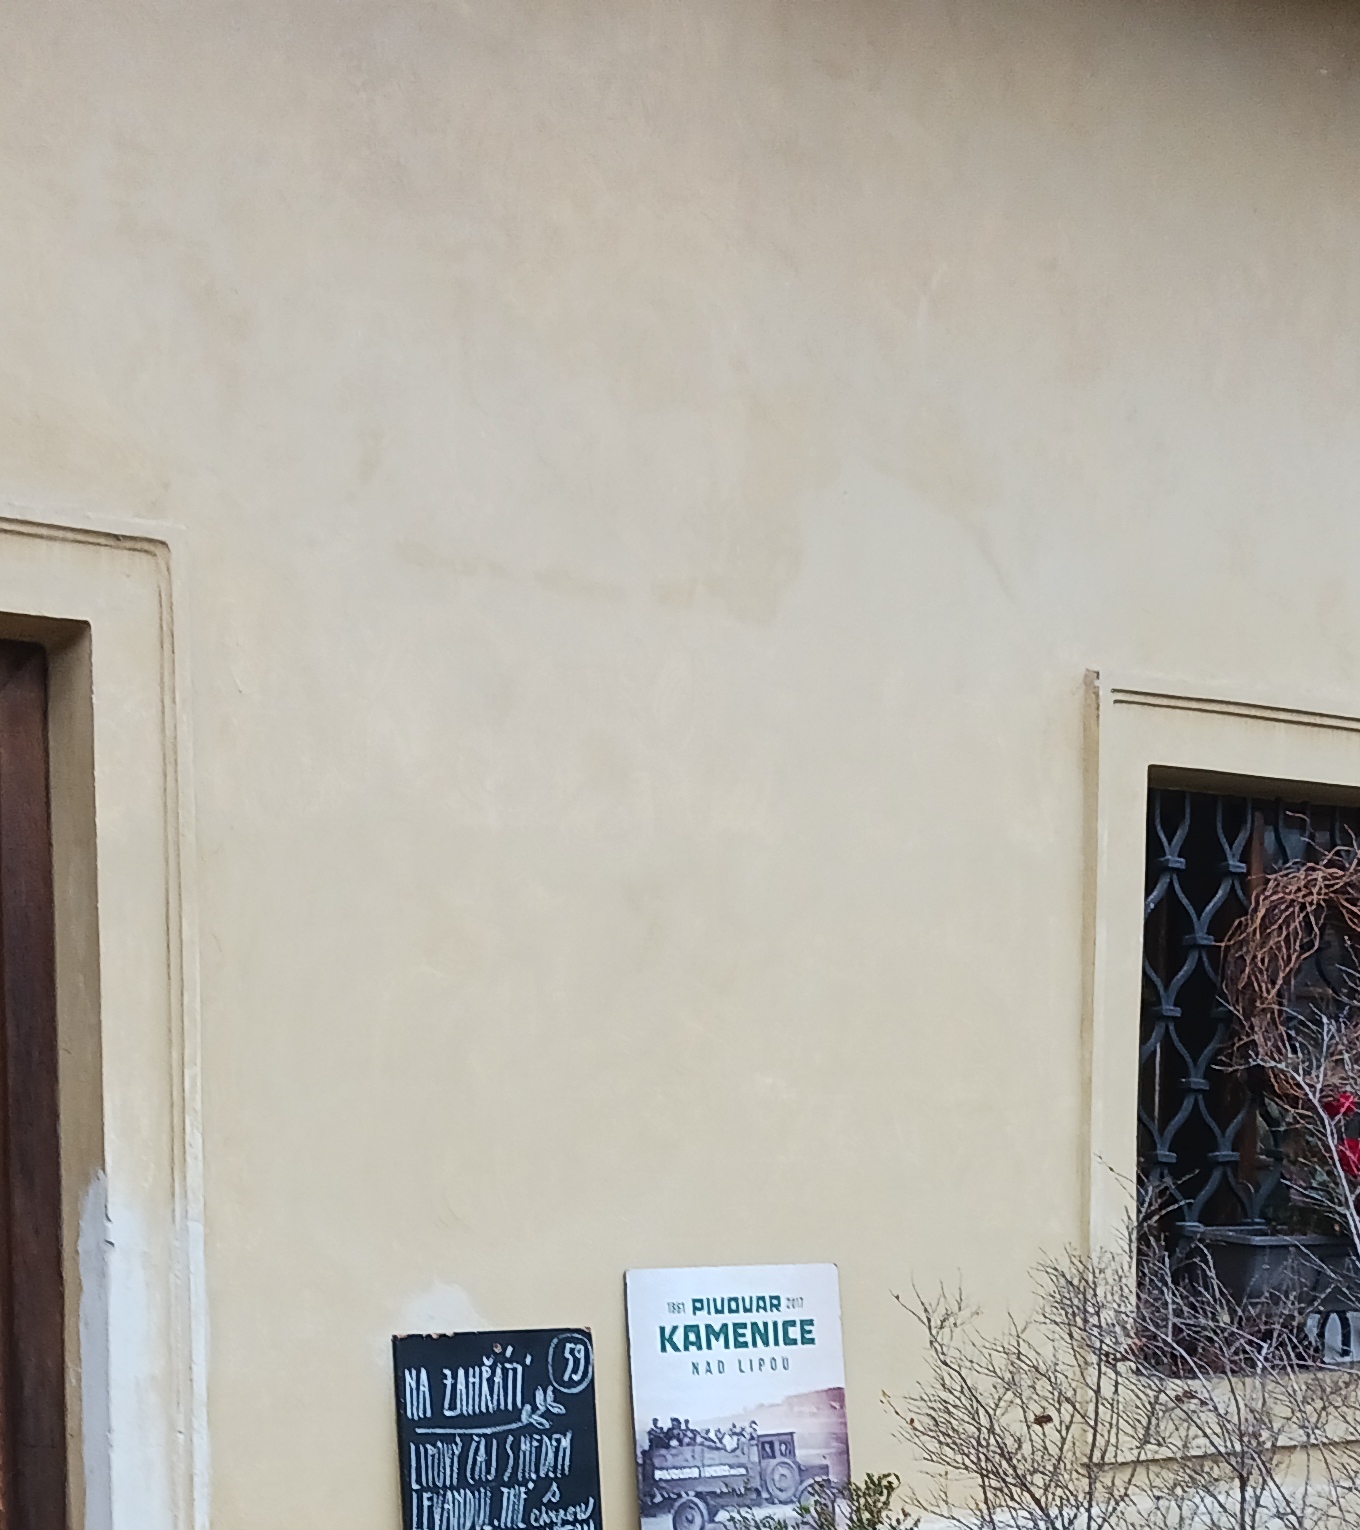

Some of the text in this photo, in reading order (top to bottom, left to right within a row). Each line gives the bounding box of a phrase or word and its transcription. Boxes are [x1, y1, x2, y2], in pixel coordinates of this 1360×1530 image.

[658, 1318, 816, 1353] KAMENICE
[563, 1343, 585, 1382] 59
[691, 1356, 790, 1376] NAD LIPOU
[404, 1344, 533, 1420] NA ZAHŘÁTÍ
